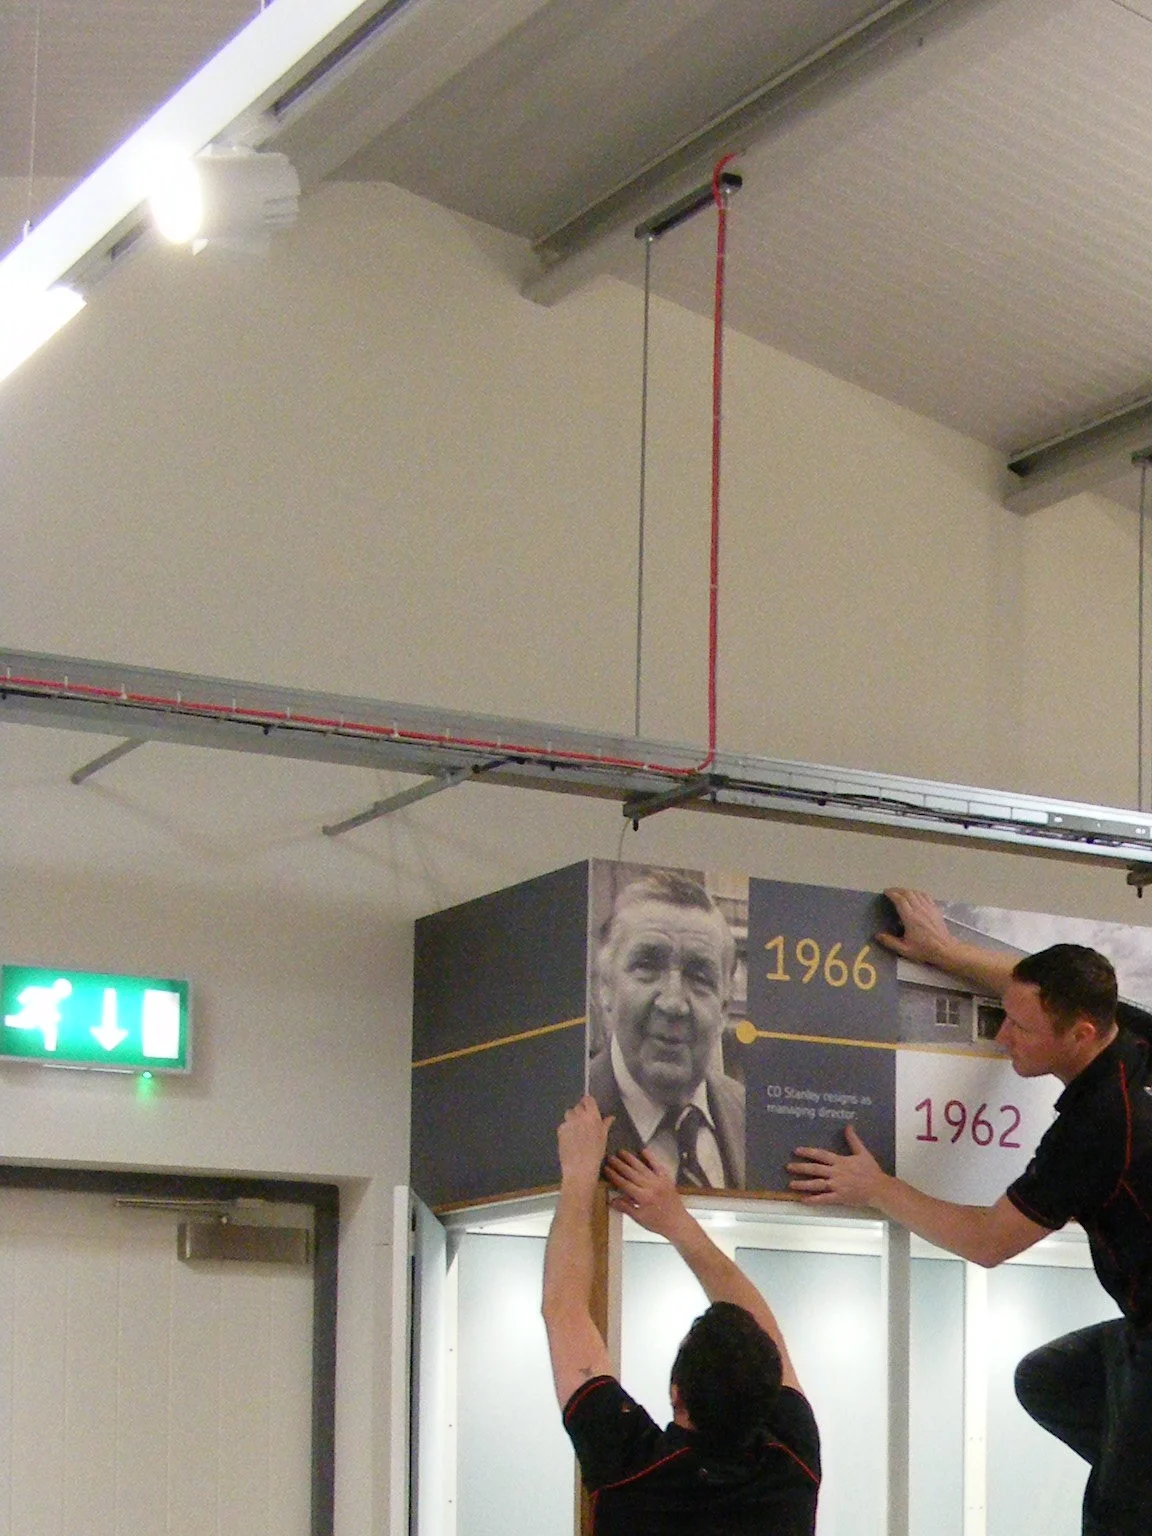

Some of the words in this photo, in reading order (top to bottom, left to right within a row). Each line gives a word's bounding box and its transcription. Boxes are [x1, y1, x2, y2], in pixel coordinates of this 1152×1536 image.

[764, 935, 877, 990] 1966
[766, 1104, 816, 1120] managing
[784, 1086, 820, 1104] Stanley
[915, 1098, 1022, 1149] 1962
